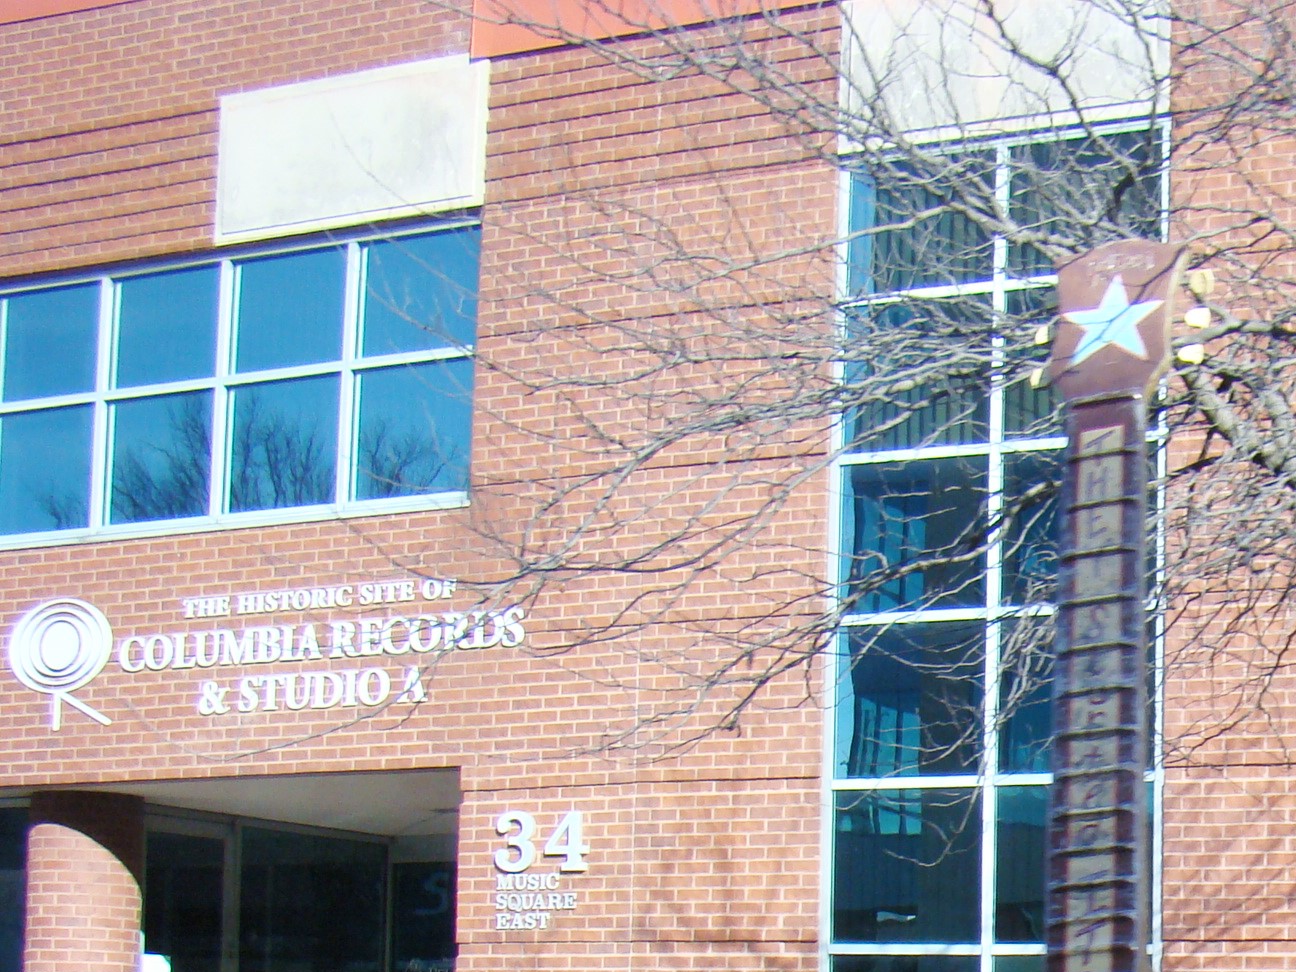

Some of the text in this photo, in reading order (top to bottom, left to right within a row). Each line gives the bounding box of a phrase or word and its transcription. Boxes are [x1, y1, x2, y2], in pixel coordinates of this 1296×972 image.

[184, 579, 457, 620] THE HISTORIC SITE OF
[119, 607, 526, 673] COLUMBIA RECORDS
[199, 666, 428, 716] & STUDIO A
[494, 810, 590, 873] 34
[495, 893, 578, 911] SQUARE
[496, 873, 560, 891] MUSIC
[495, 912, 551, 930] EAST
